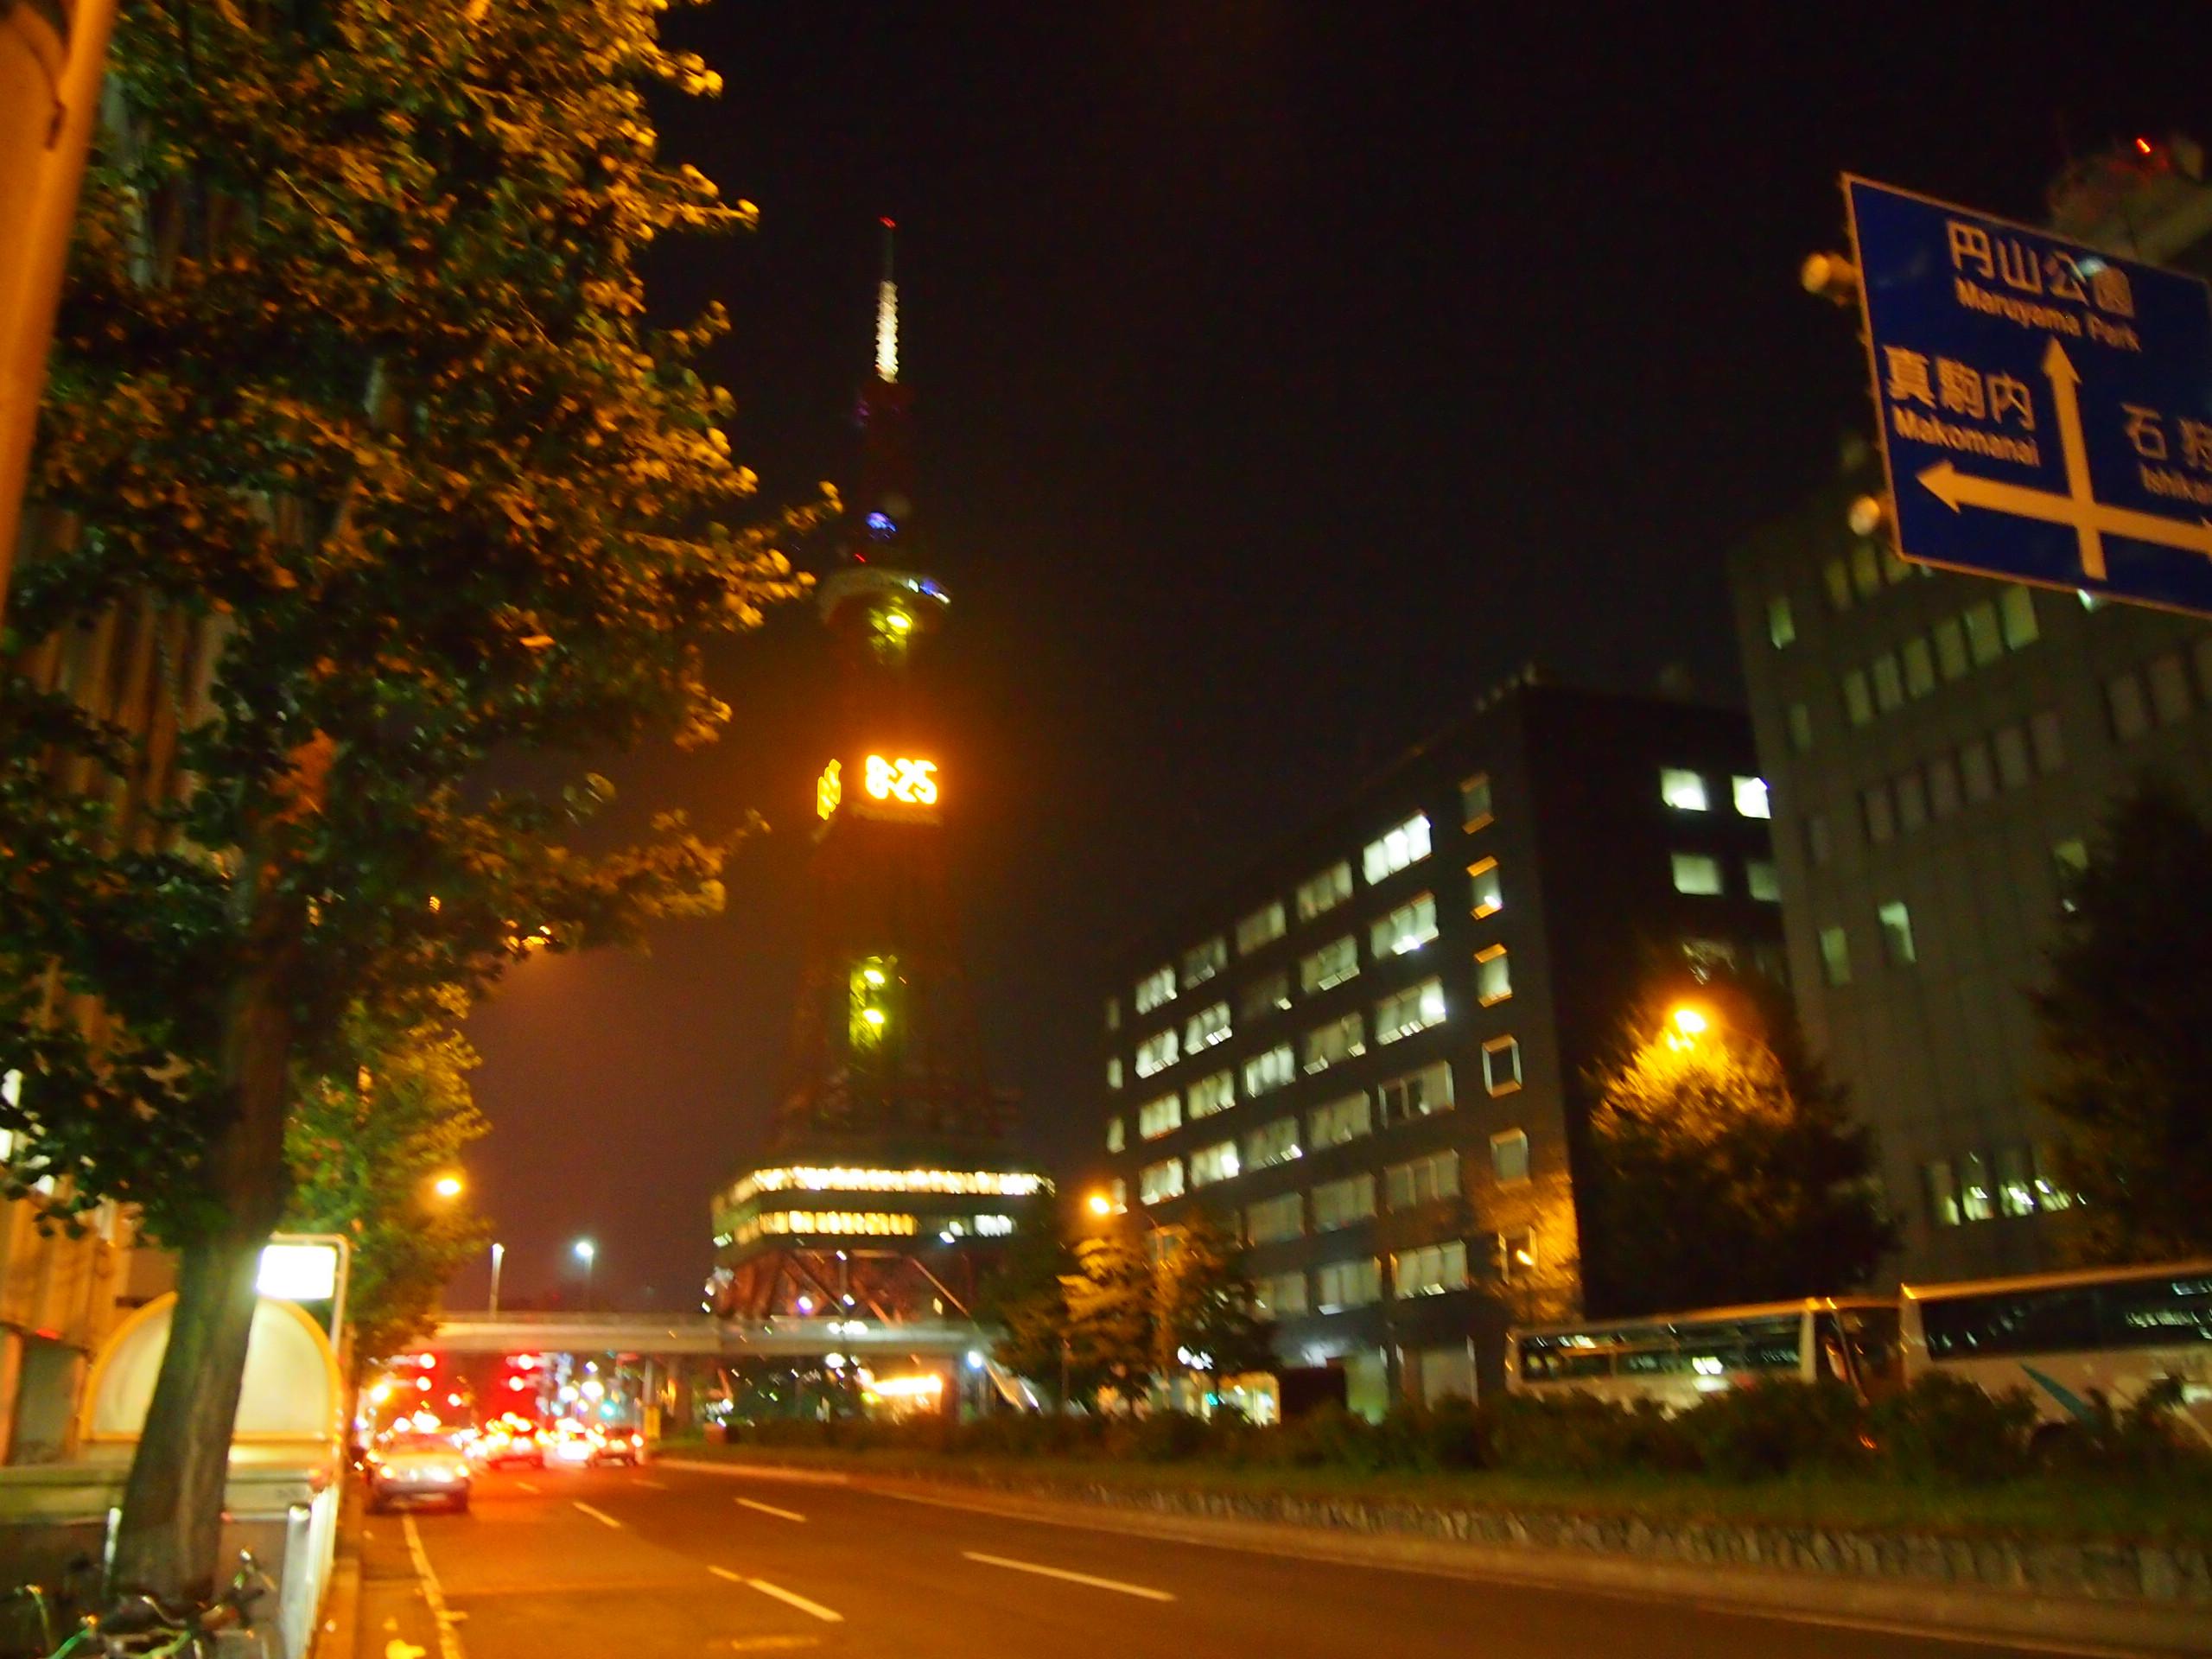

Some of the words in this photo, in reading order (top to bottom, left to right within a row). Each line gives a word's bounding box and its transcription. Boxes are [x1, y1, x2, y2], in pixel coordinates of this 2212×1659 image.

[1947, 218, 2135, 318] 円山公園
[1954, 276, 2082, 338] Maruyama
[1883, 345, 2037, 432] 真駒内
[1892, 404, 2042, 467] Makomanai
